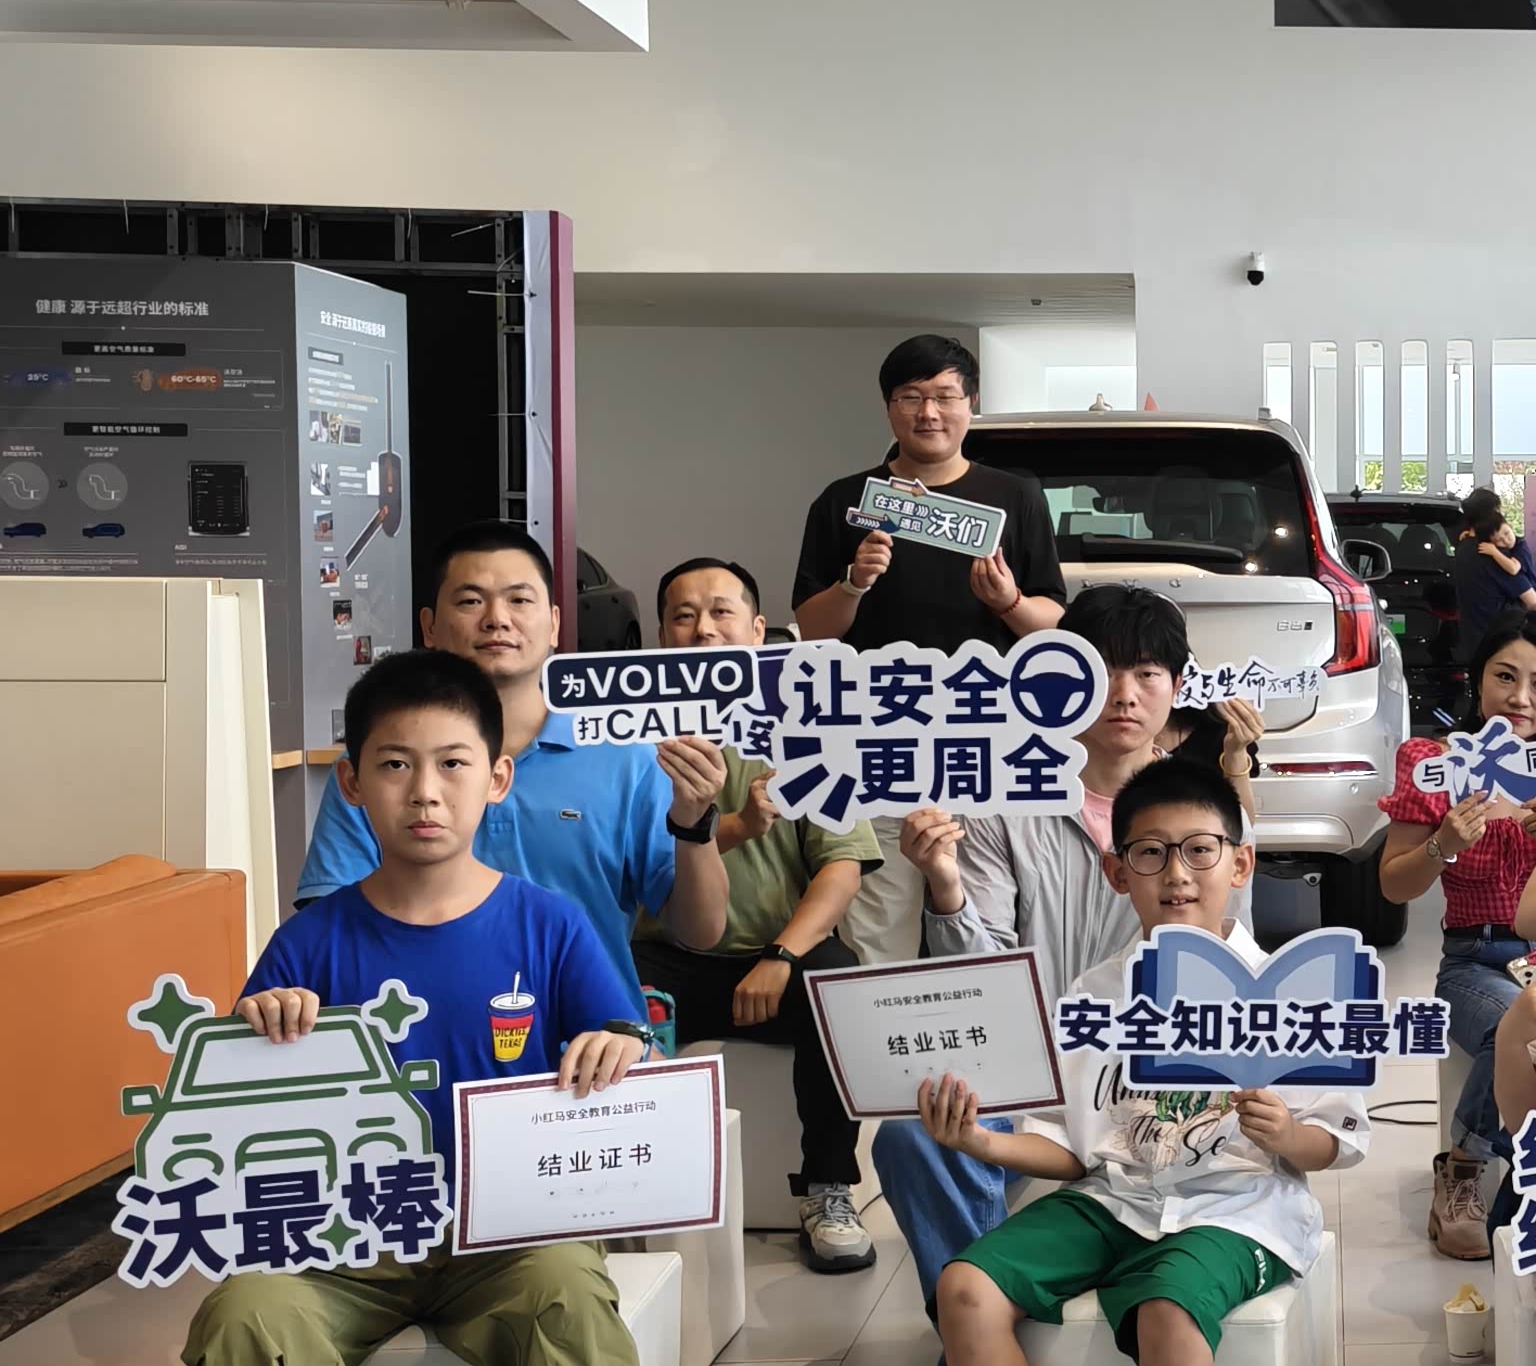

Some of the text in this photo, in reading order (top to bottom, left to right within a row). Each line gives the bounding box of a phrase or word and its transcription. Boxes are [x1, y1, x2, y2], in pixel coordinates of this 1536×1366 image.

[35, 299, 209, 317] 健康 源于远超行业的标准
[874, 494, 916, 517] 在这里
[900, 518, 922, 533] 遇见
[926, 508, 988, 547] 沃们
[560, 659, 744, 699] 为VOLVO
[795, 656, 1010, 727] 让安全
[578, 702, 723, 741] 打CALL
[857, 734, 1071, 804] 更周全
[873, 988, 983, 1008] 小红马安全教育公益行动
[887, 1025, 987, 1056] 结业证书
[1059, 998, 1449, 1056] 安全知识沃最懂
[531, 1100, 657, 1125] 小红马安全教育公益行动
[537, 1143, 652, 1177] 结业证书
[120, 1158, 445, 1283] 沃最棒
